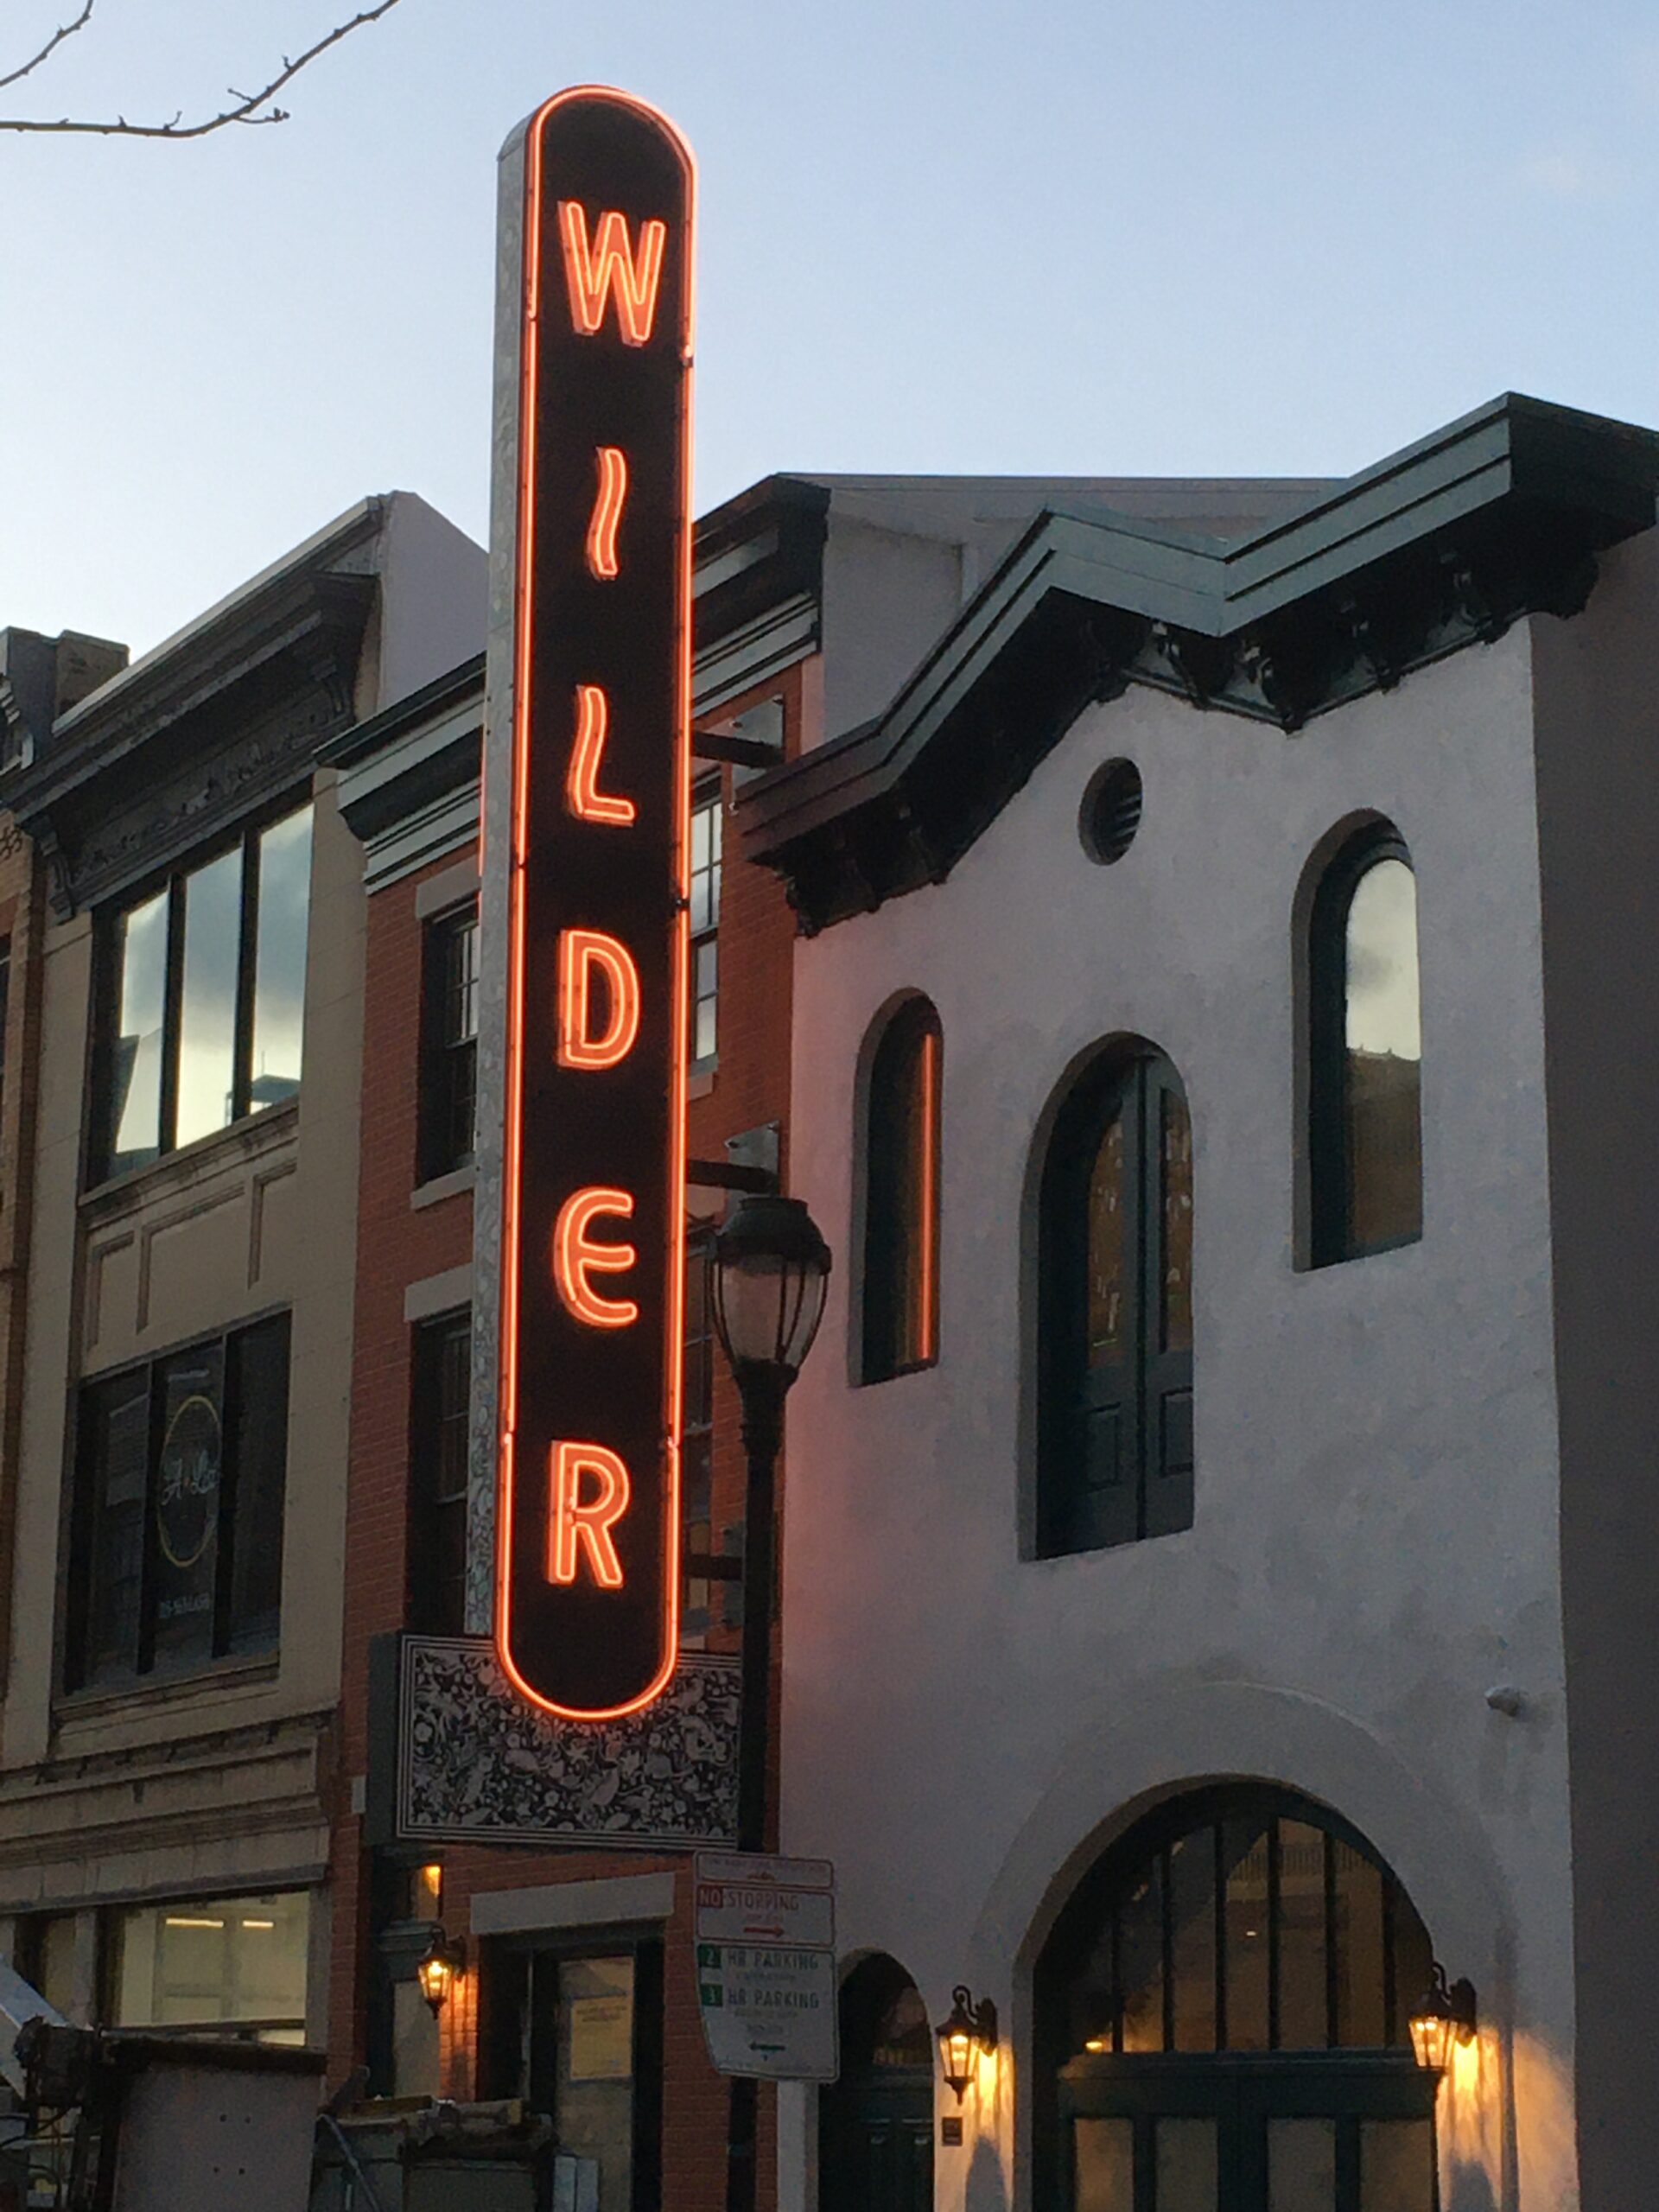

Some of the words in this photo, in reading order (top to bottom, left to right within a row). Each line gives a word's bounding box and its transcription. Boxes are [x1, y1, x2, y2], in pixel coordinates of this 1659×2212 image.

[547, 200, 667, 1590] WILDER
[700, 1888, 721, 1908] NO
[727, 1890, 800, 1911] STOPPING
[707, 1948, 715, 1966] 2
[728, 1950, 747, 1967] HR
[753, 1950, 819, 1971] PARKING
[708, 1986, 716, 2004] 3
[728, 1987, 747, 2005] HR
[753, 1989, 820, 2009] PARKING
